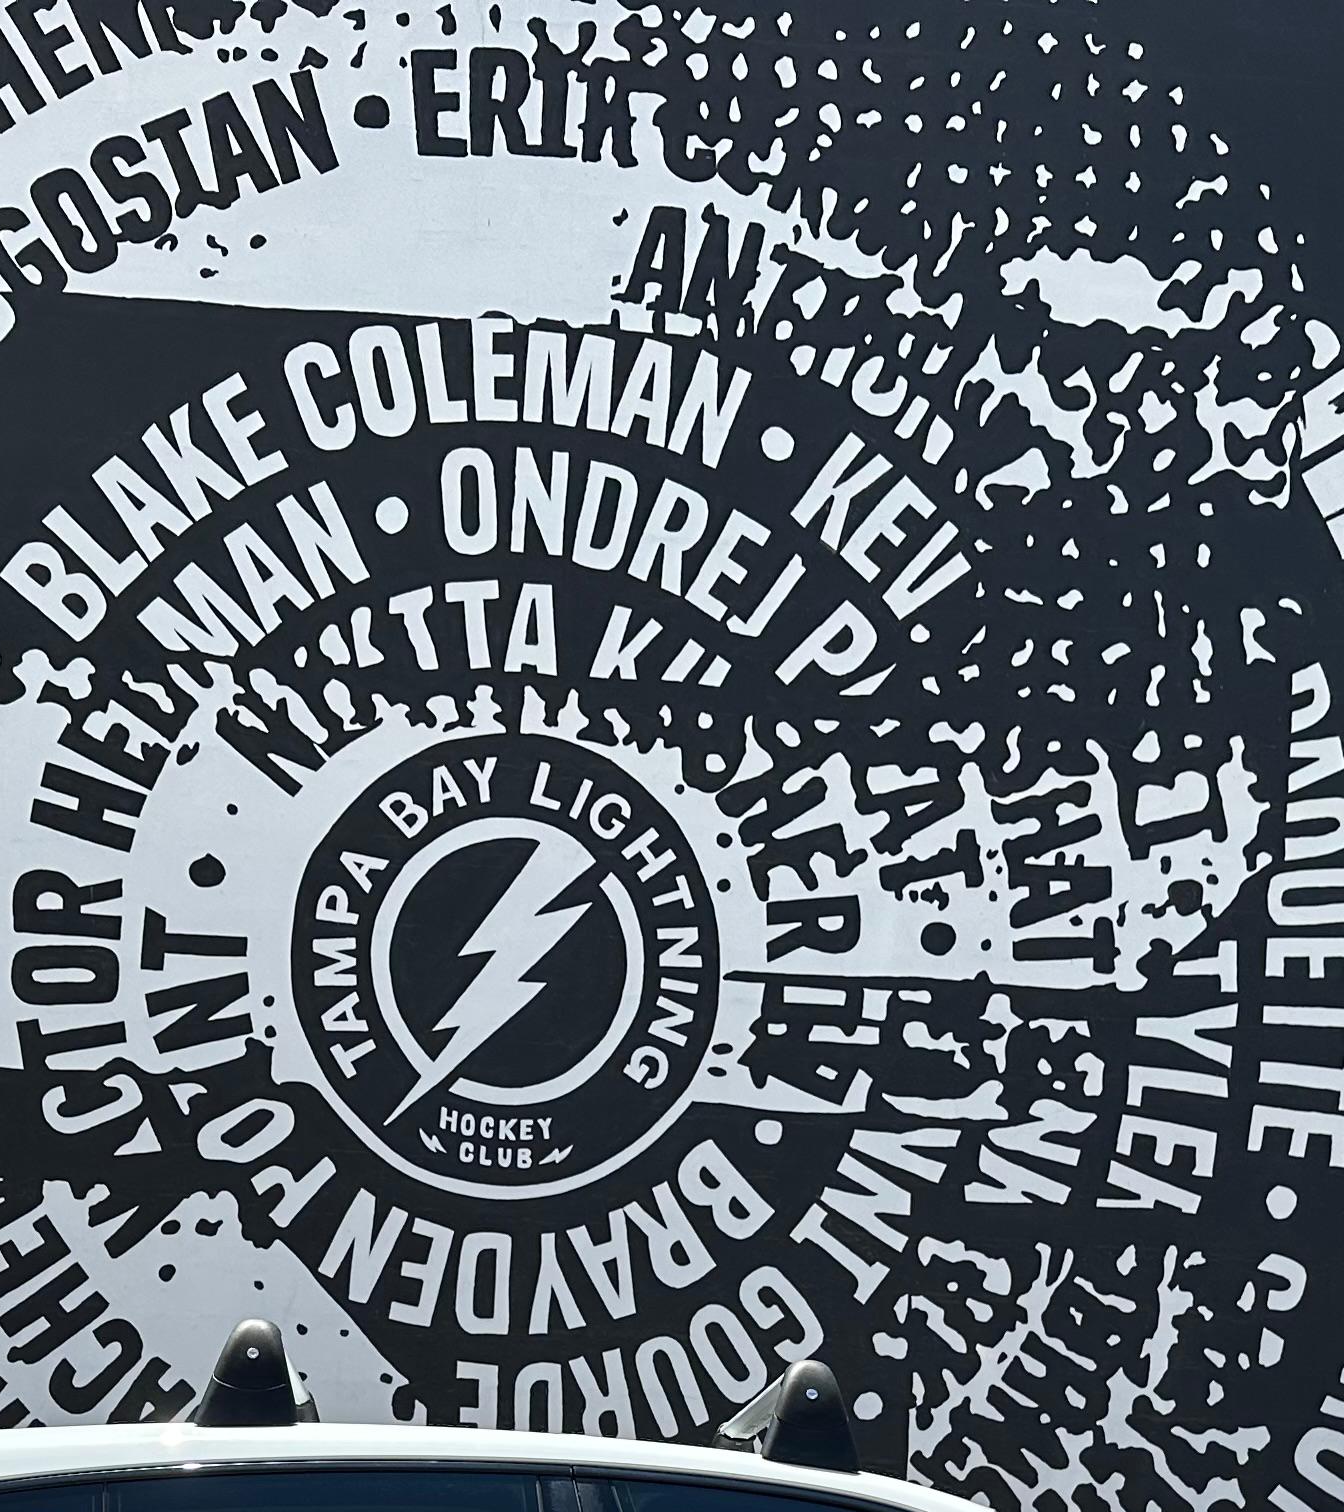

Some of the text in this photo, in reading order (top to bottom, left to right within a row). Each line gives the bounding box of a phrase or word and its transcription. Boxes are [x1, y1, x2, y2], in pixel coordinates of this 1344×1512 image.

[411, 46, 640, 168] ERIK
[0, 372, 289, 642] BLAKE
[284, 318, 753, 469] COLEMAN
[441, 447, 807, 638] ONDREJ
[790, 432, 972, 620] KEV
[311, 850, 391, 1079] TAMPA
[378, 756, 498, 839] BAY
[529, 761, 704, 1090] LIGHTNING
[439, 1106, 554, 1142] HOCKEY
[458, 1140, 534, 1169] CLUB
[318, 1139, 775, 1335] BRAYDEN
[455, 1265, 824, 1441] GOURDE
